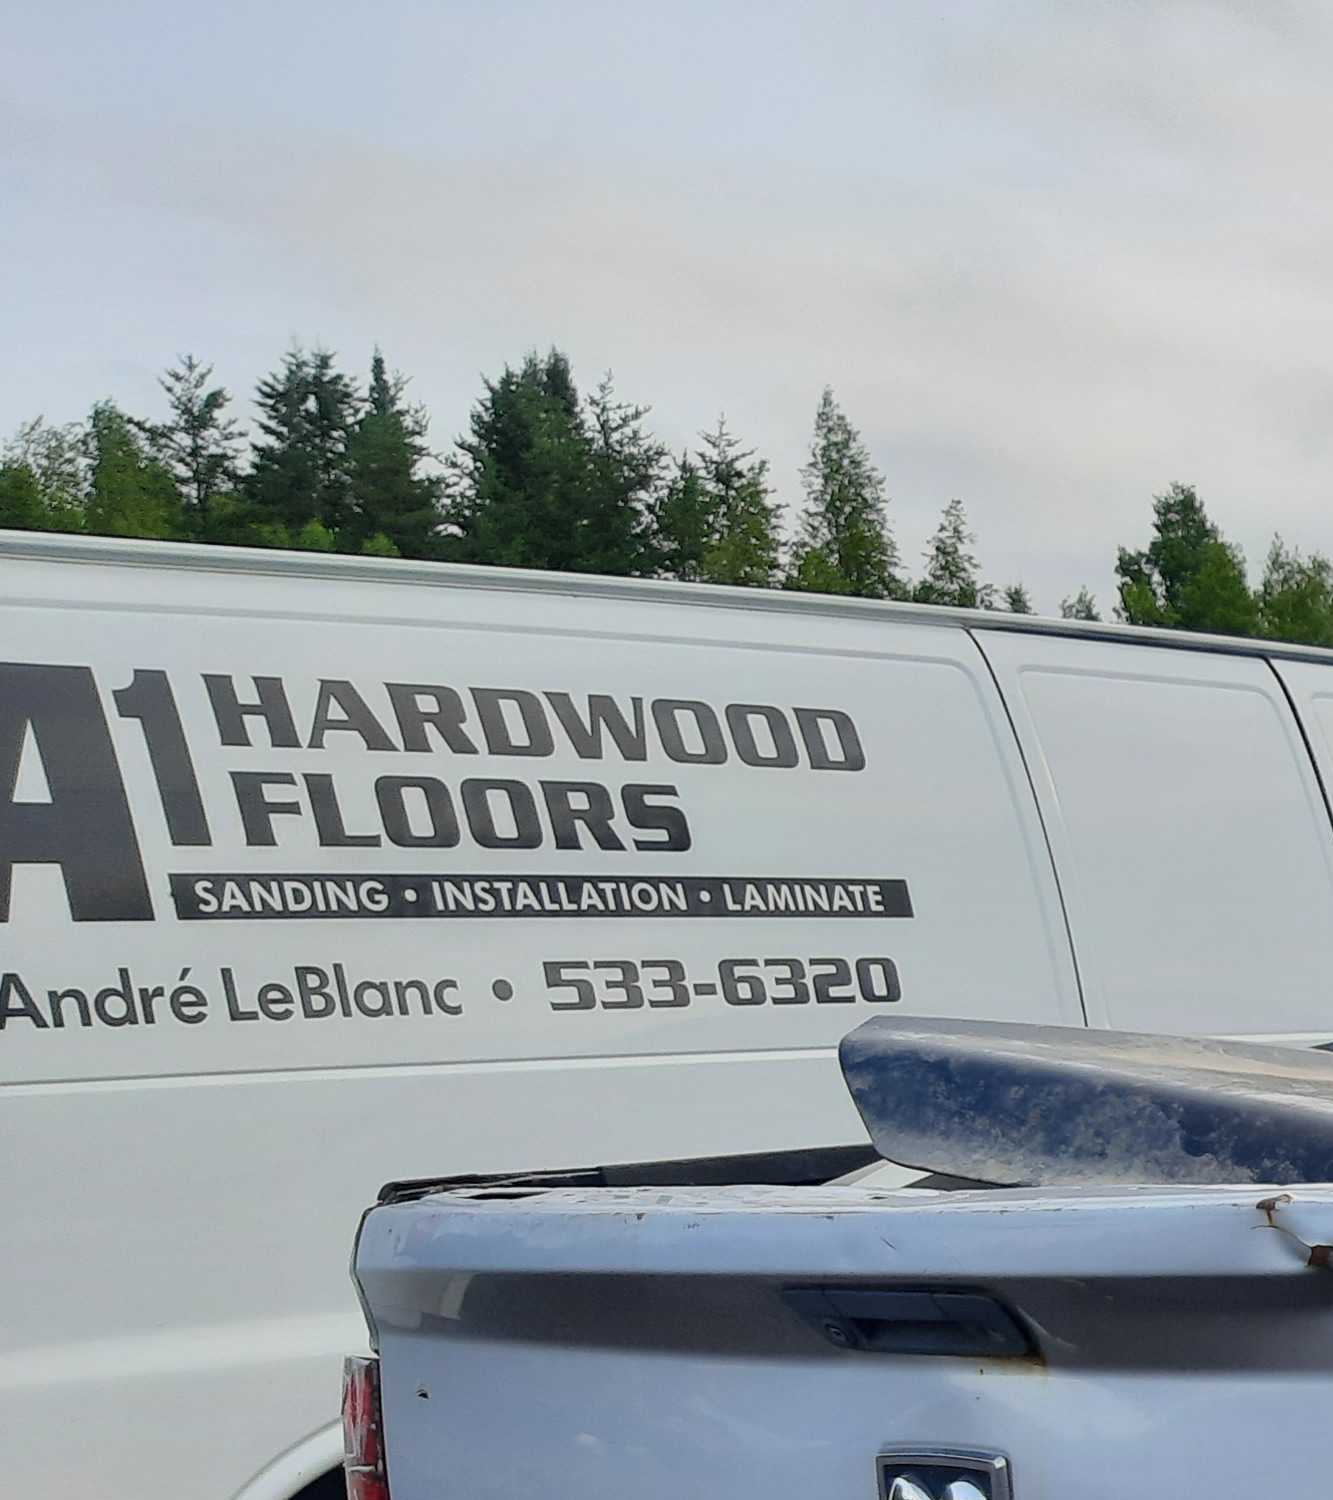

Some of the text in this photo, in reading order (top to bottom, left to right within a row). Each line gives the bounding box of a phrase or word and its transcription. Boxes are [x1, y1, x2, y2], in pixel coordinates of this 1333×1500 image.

[200, 673, 866, 773] HARDWOOD
[230, 770, 693, 852] FLOORS
[195, 879, 885, 914] SANDING INSTALLATION LAMINATE
[0, 957, 903, 1030] André LeBlanc 533-6320
